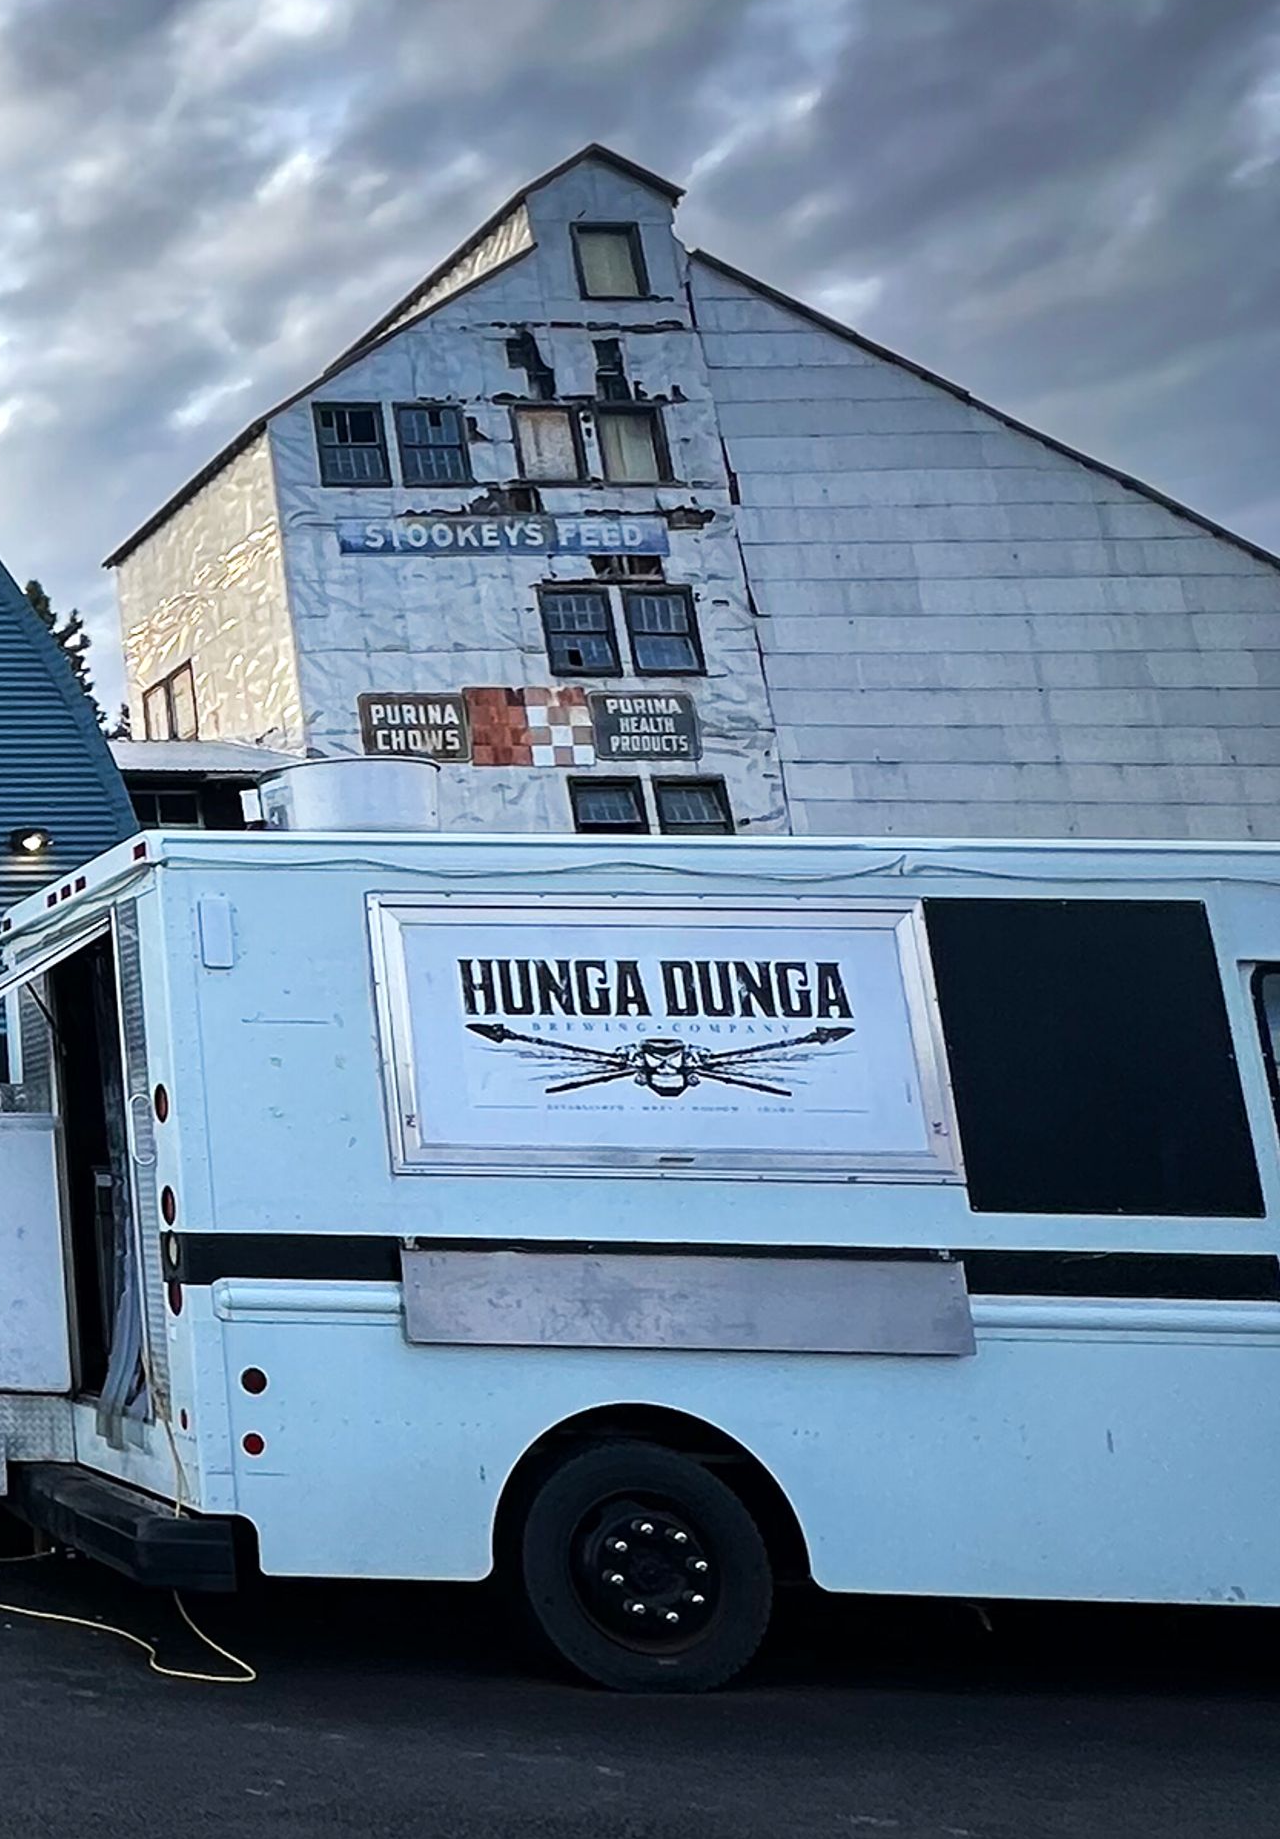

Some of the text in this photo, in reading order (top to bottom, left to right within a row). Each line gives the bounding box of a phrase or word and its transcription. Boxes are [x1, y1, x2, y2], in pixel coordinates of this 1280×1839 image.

[557, 522, 644, 548] FEED
[370, 702, 460, 727] PURINA
[605, 698, 683, 715] PURINA
[619, 716, 677, 735] HEALTH
[374, 728, 462, 753] CHOWS
[609, 735, 690, 753] PRODUCTS
[457, 958, 856, 1020] HUNGA DUNGA
[531, 1021, 793, 1036] BREWING COMPANY
